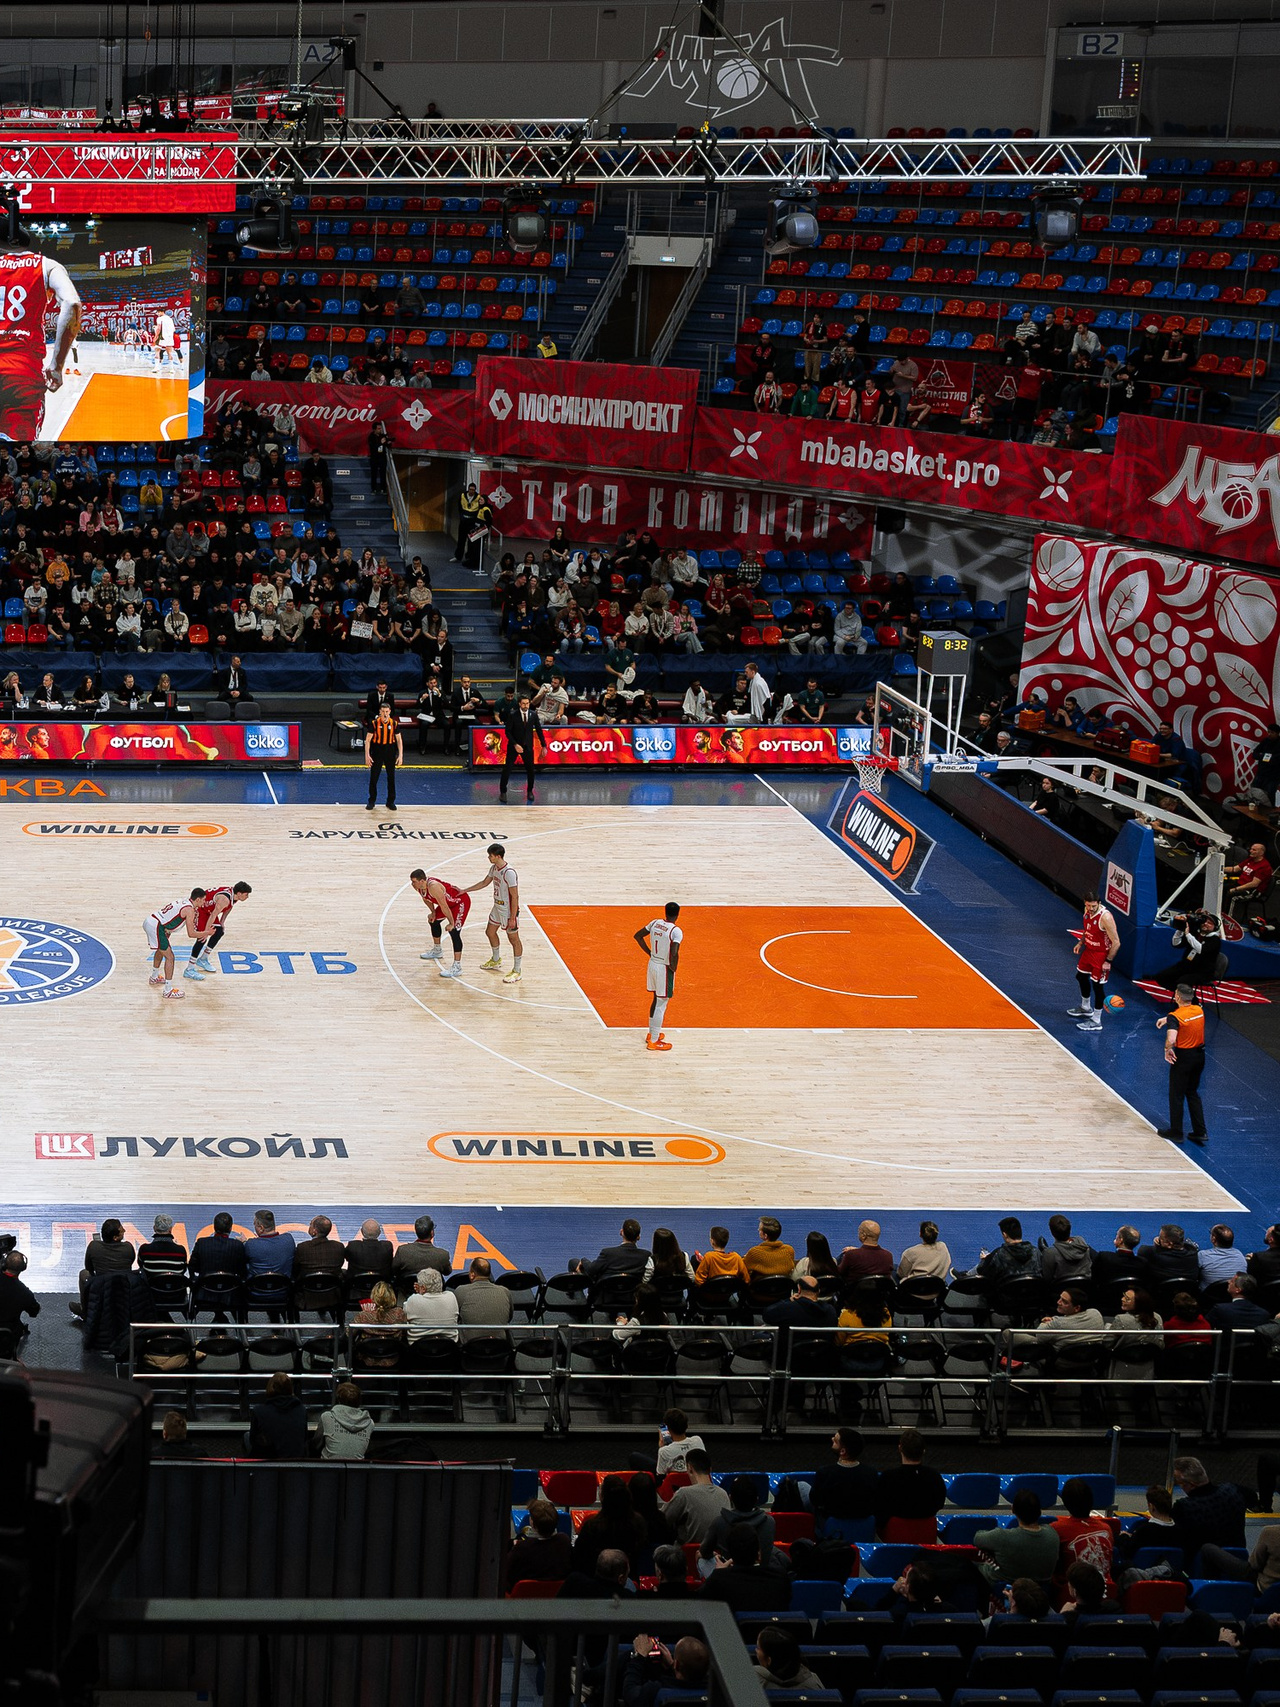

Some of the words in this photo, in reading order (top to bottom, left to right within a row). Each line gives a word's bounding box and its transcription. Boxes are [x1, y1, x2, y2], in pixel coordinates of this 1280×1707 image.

[303, 44, 336, 62] A2
[1082, 34, 1119, 54] B2
[49, 187, 56, 204] 1
[517, 392, 683, 433] МОСИНЖПРОЕКТ
[800, 436, 1001, 487] mbabasket.pro
[521, 480, 618, 525] ТВОЯ
[944, 639, 968, 651] 8:32
[110, 736, 174, 748] ФУТБОЛ
[549, 739, 614, 752] ФУТБОЛ
[758, 739, 823, 752] ФУТБОЛ
[39, 823, 182, 834] WINLINE
[288, 828, 509, 841] ЗАРУБЕЖНЕФТЬ
[847, 801, 901, 861] WINLINE
[49, 928, 88, 945] ВТБ
[217, 951, 357, 975] ВТБ
[14, 974, 96, 1003] LEAGUE
[99, 1132, 349, 1159] ЛУКОЙЛ
[452, 1138, 657, 1158] WINLINE
